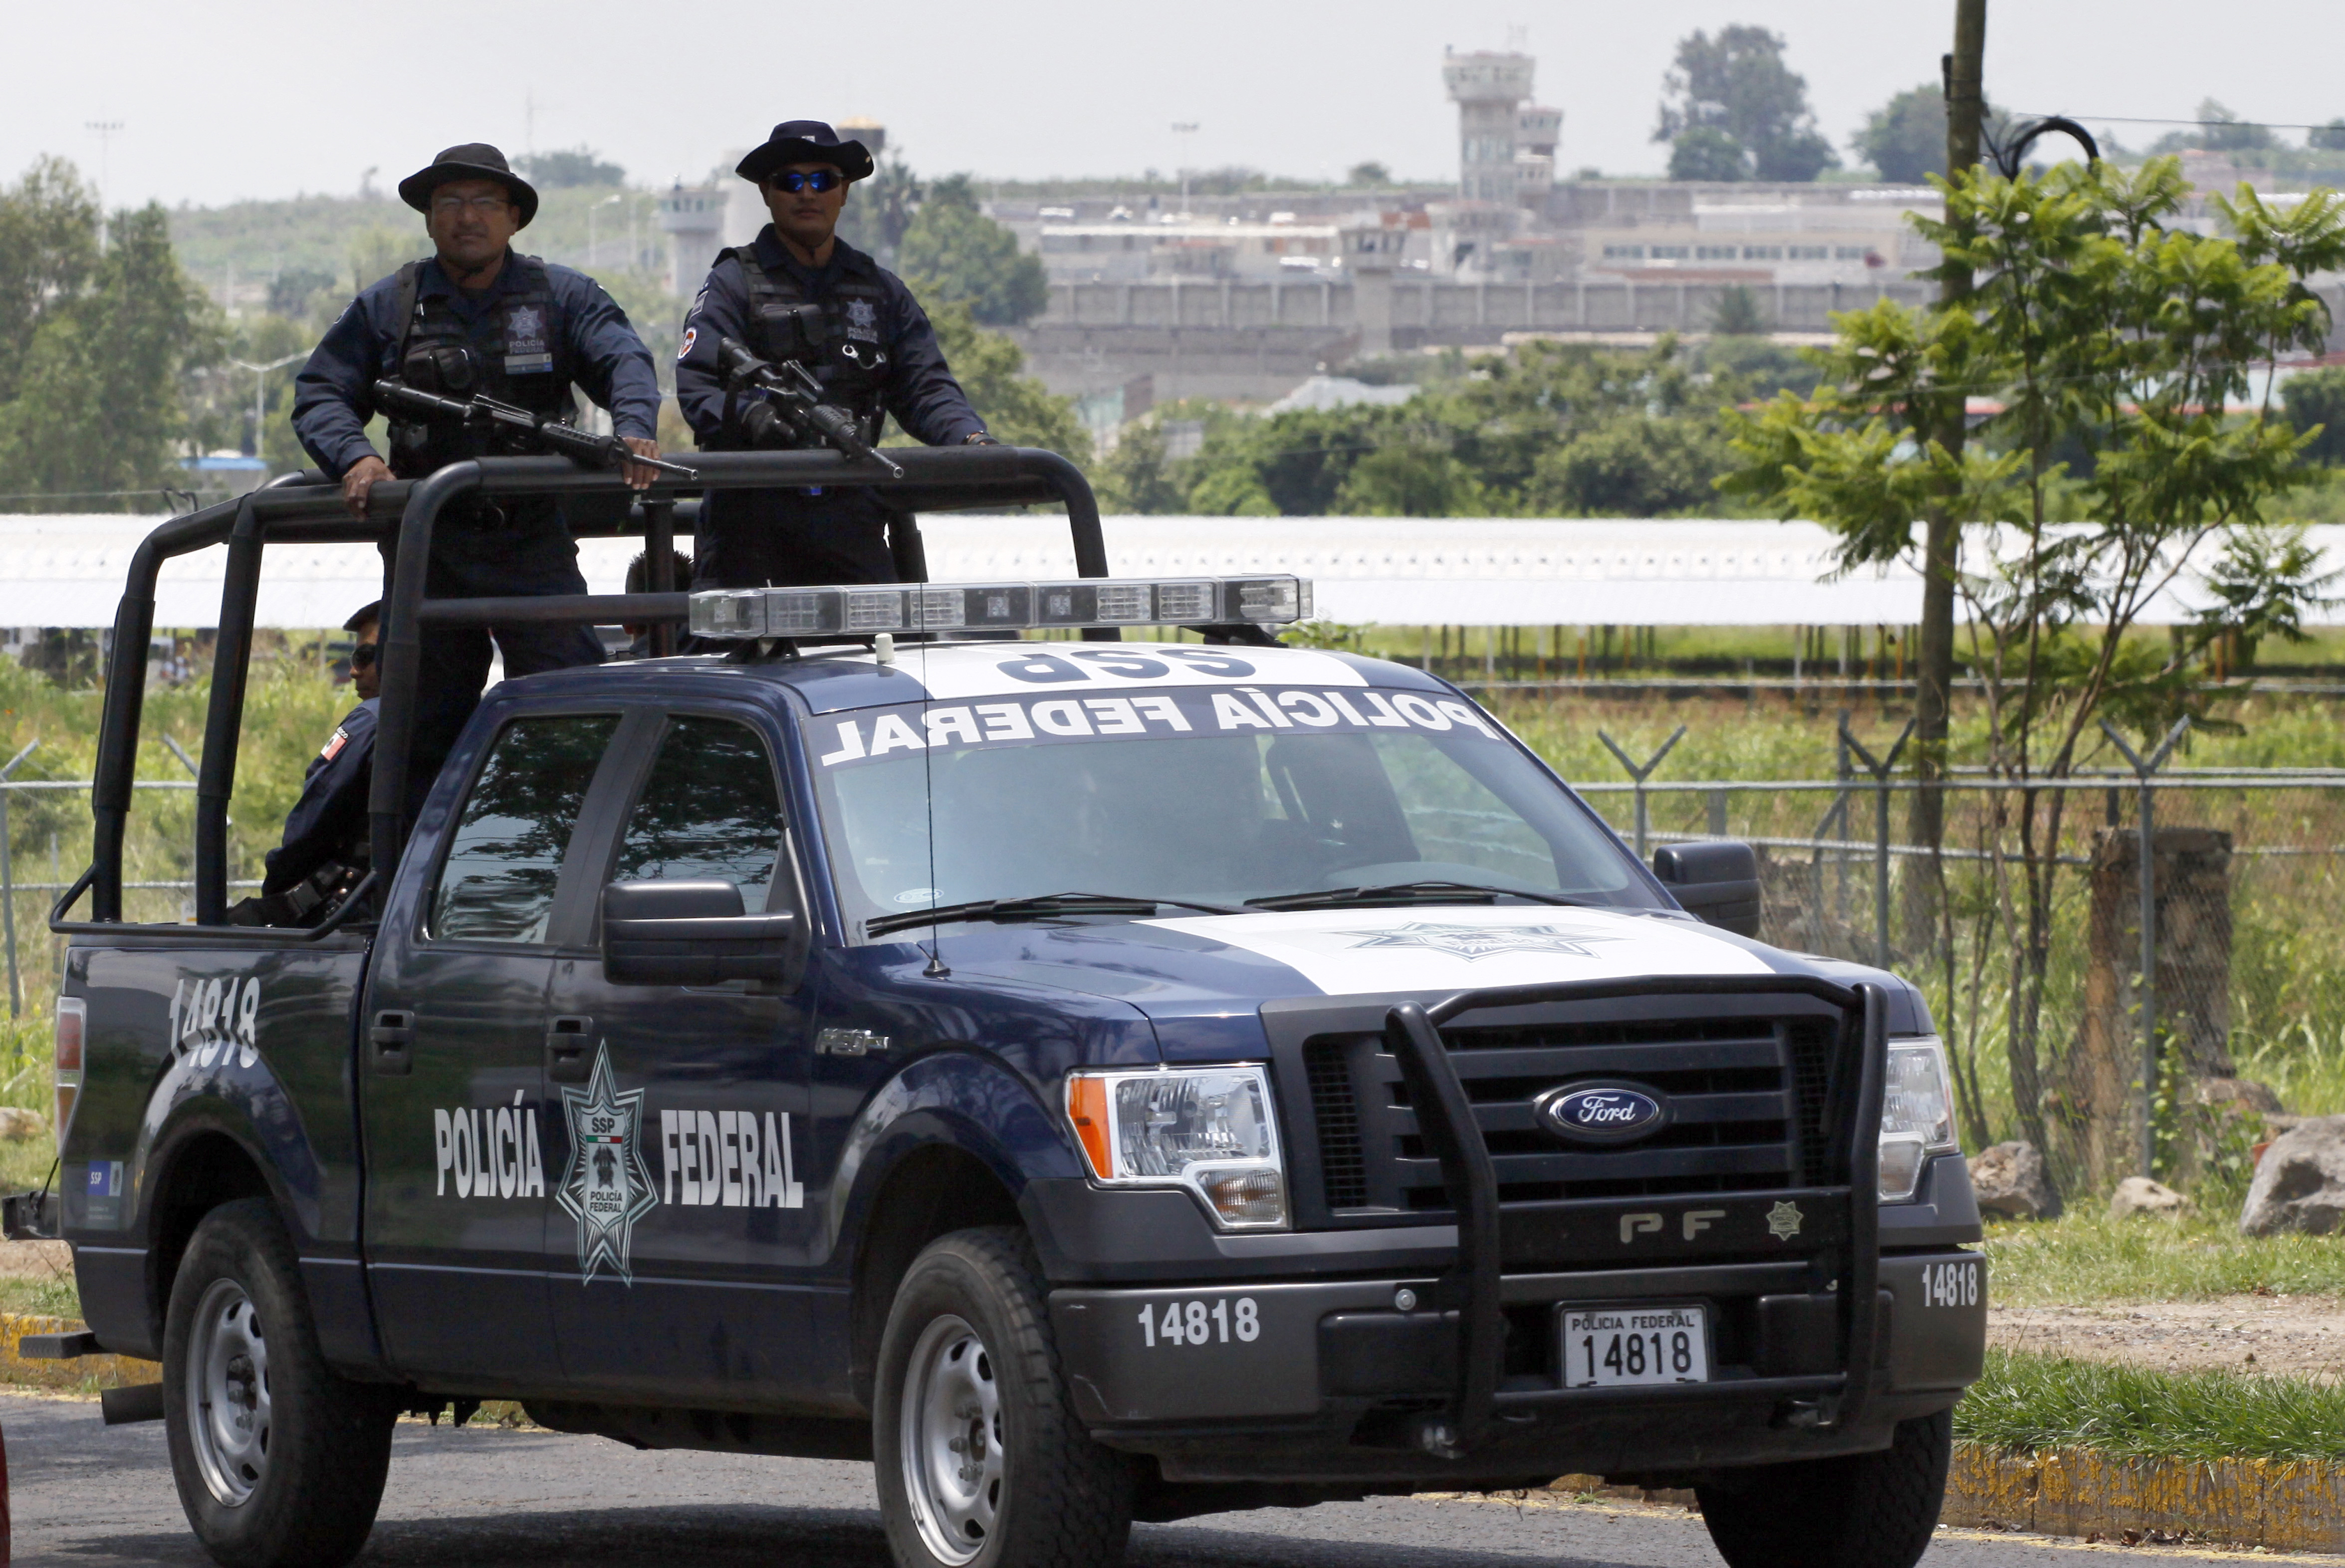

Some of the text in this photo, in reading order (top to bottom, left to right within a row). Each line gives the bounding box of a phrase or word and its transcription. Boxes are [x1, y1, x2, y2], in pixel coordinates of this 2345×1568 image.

[996, 649, 1256, 683] SSP
[169, 977, 260, 1068] 14818
[1578, 1096, 1636, 1122] Ford
[592, 1117, 615, 1133] SSP
[435, 1089, 803, 1208] POLICÍA FEDERAL
[90, 1171, 102, 1184] SSP
[590, 1202, 622, 1212] FEDERAL
[591, 1190, 622, 1201] POLICÍA
[1922, 1263, 1978, 1307] 14818
[1138, 1297, 1260, 1346] 14818
[1572, 1315, 1695, 1331] POLICIA FEDERAL
[1583, 1331, 1691, 1377] 14818
